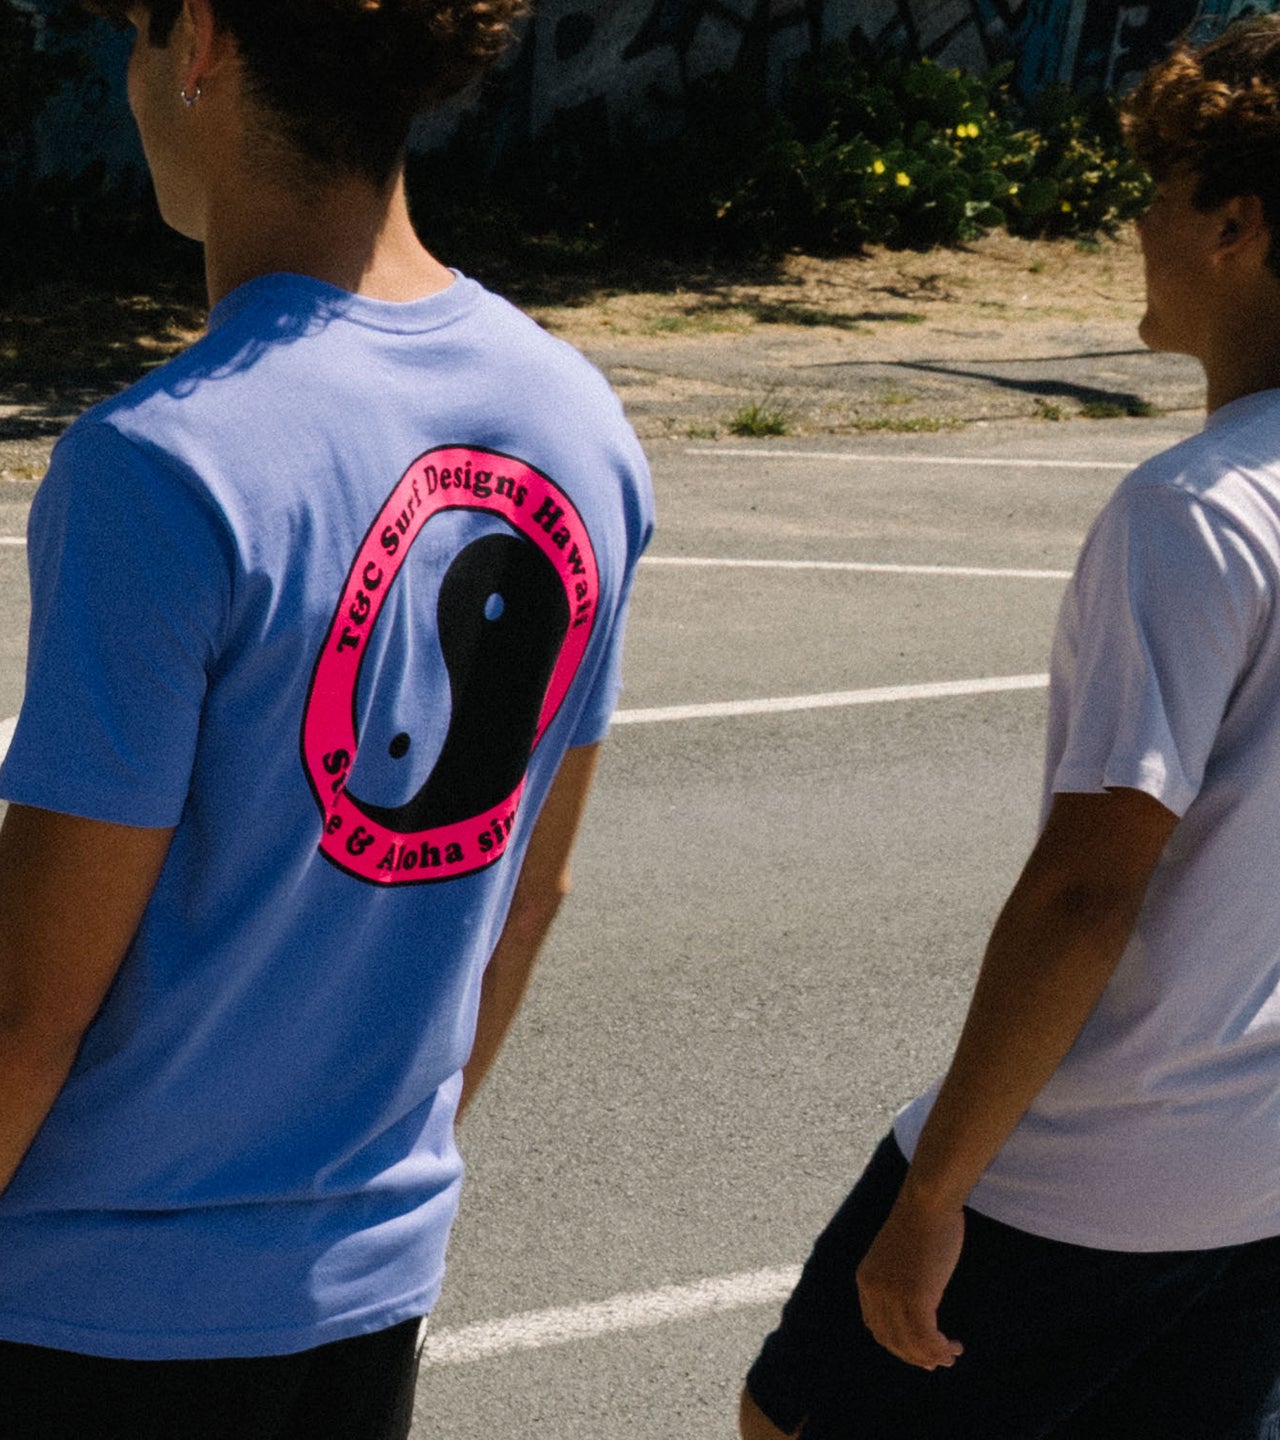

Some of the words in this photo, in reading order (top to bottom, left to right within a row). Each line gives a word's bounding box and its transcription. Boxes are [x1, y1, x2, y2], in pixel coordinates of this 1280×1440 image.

[336, 561, 383, 653] T&C
[380, 479, 422, 557] Surf
[423, 461, 528, 508] Designs
[532, 496, 592, 630] Hawaii
[346, 826, 375, 856] &
[376, 841, 464, 871] Aloha
